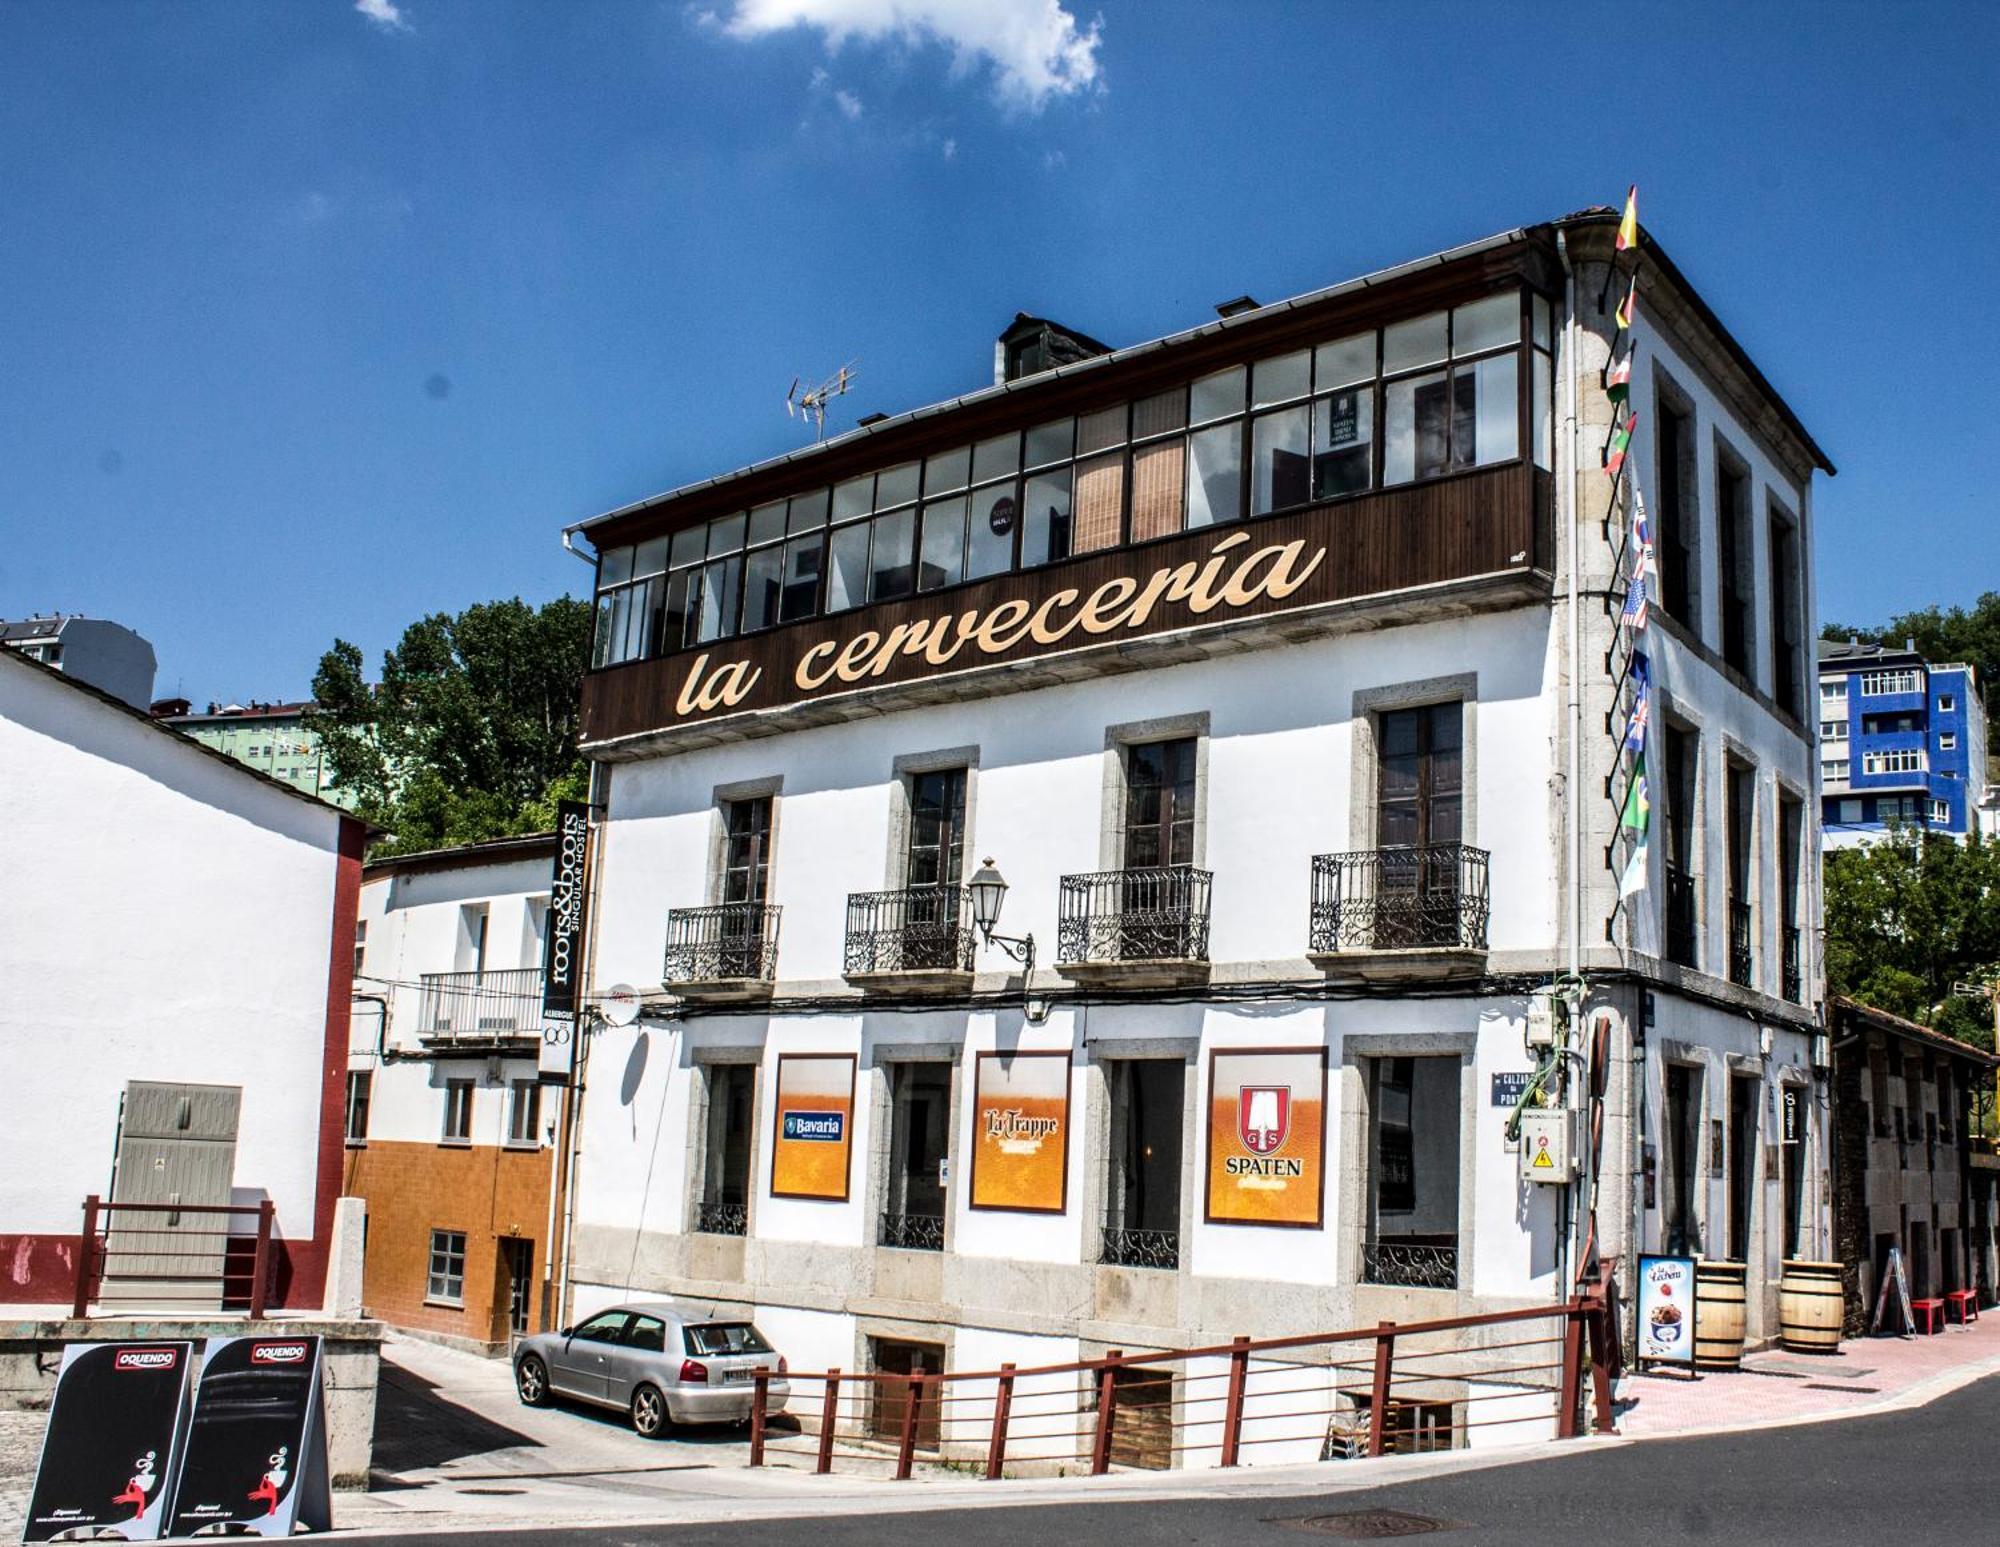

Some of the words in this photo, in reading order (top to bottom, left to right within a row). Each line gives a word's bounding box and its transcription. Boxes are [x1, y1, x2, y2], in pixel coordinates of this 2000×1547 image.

[676, 654, 762, 716] la
[795, 531, 1327, 691] cervecería
[576, 818, 587, 863] HOSTEL
[553, 813, 579, 986] roots&boots
[571, 867, 583, 932] SINGULAR
[1501, 1094, 1521, 1104] PONT
[796, 1118, 839, 1134] Bavaria
[1002, 1108, 1058, 1140] Trappe
[1247, 1133, 1257, 1144] G
[1268, 1133, 1278, 1144] S
[1226, 1158, 1302, 1176] SPATEN
[120, 1353, 173, 1366] OQUENDO
[256, 1346, 305, 1361] OQUENDO
